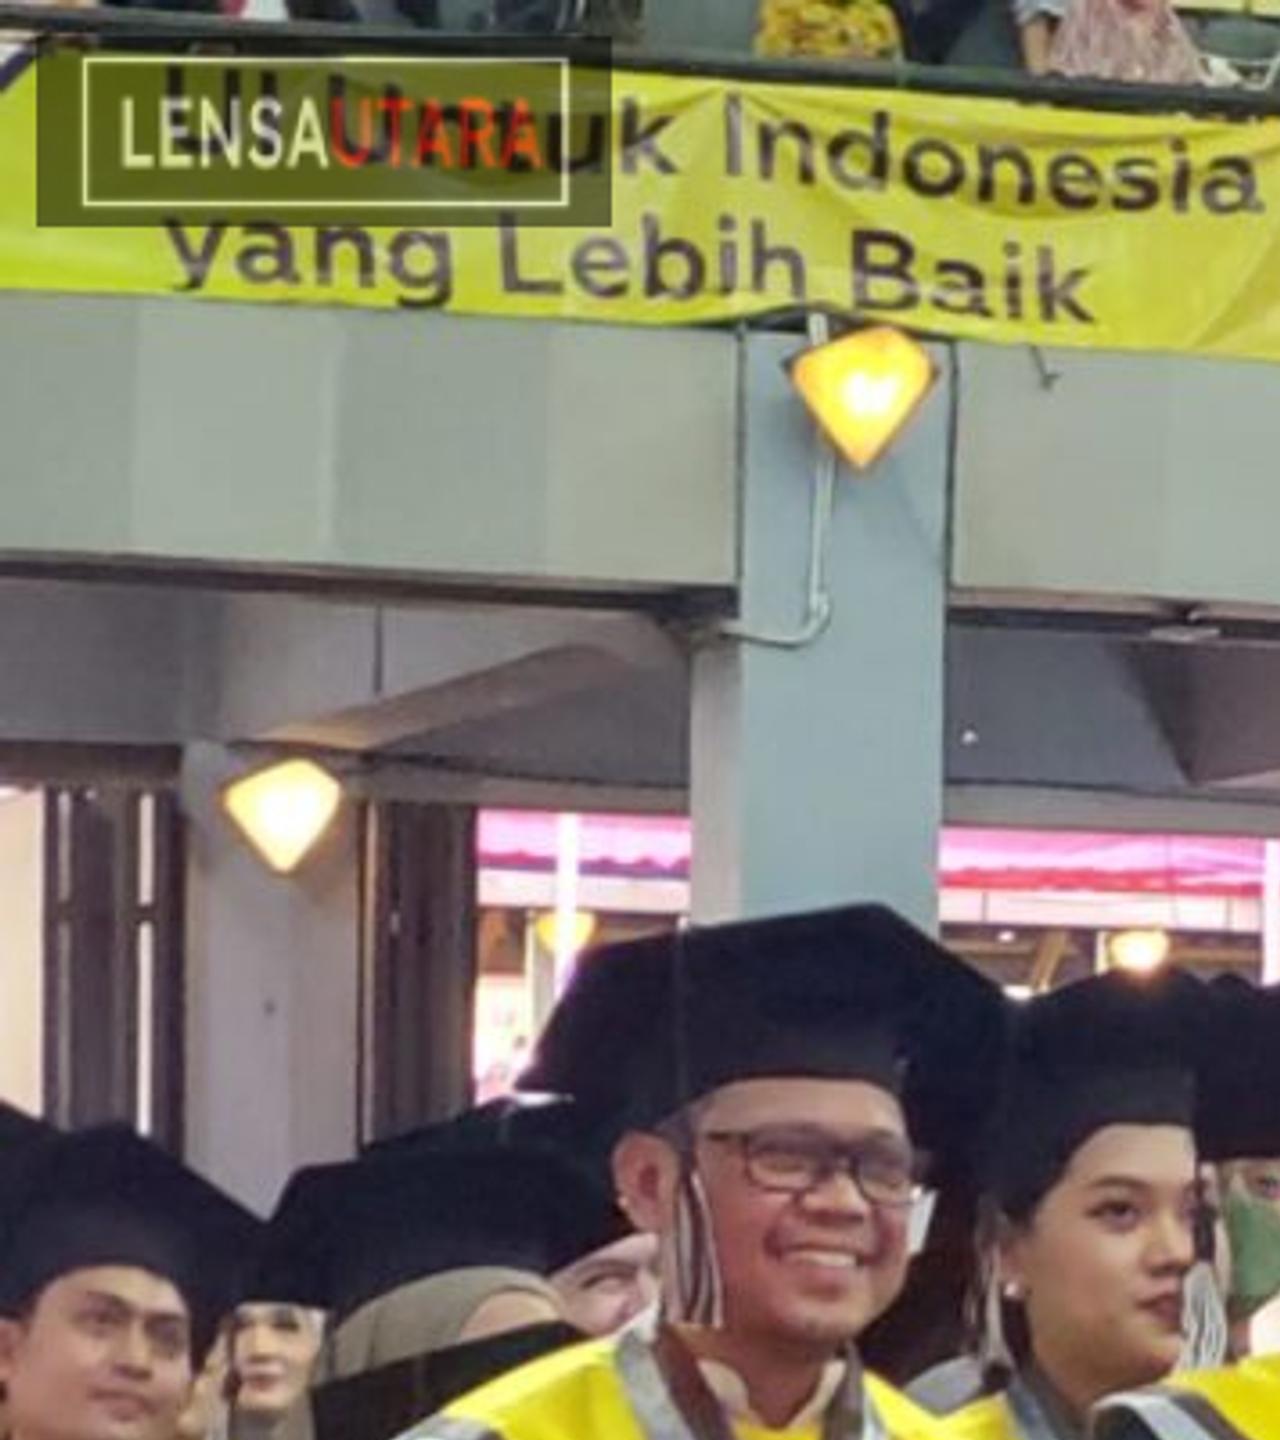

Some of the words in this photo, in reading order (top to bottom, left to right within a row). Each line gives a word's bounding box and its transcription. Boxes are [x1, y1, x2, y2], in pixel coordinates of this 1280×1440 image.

[723, 90, 1265, 214] Indonesia
[160, 214, 454, 308] yang
[500, 210, 808, 299] Lebih
[850, 227, 1095, 325] Baik
